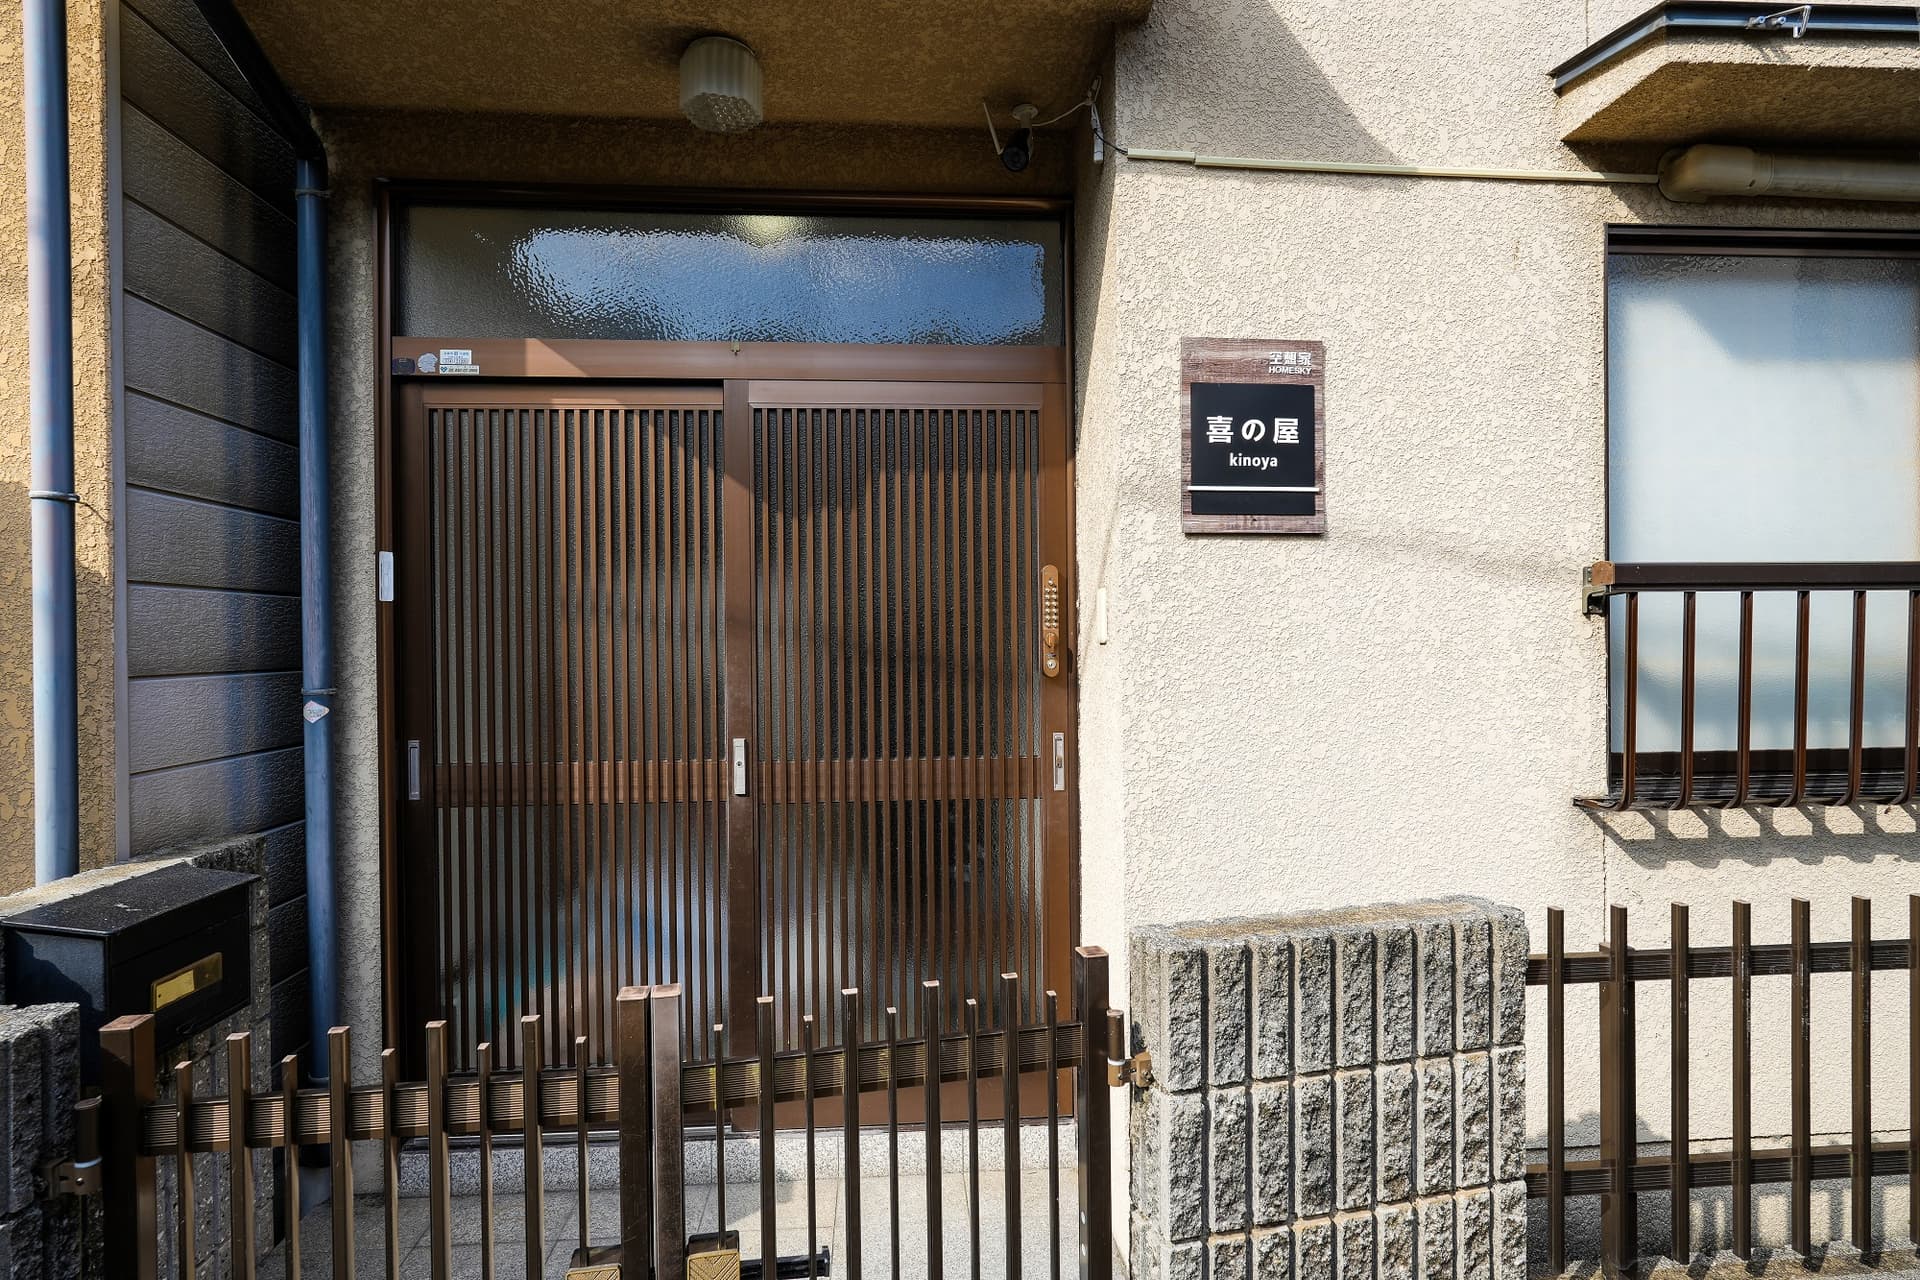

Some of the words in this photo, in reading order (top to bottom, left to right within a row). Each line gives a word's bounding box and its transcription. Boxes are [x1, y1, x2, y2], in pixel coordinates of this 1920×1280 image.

[1268, 366, 1312, 375] HOMESKY
[1206, 415, 1300, 444] 喜の屋
[1229, 453, 1278, 470] kinoya
